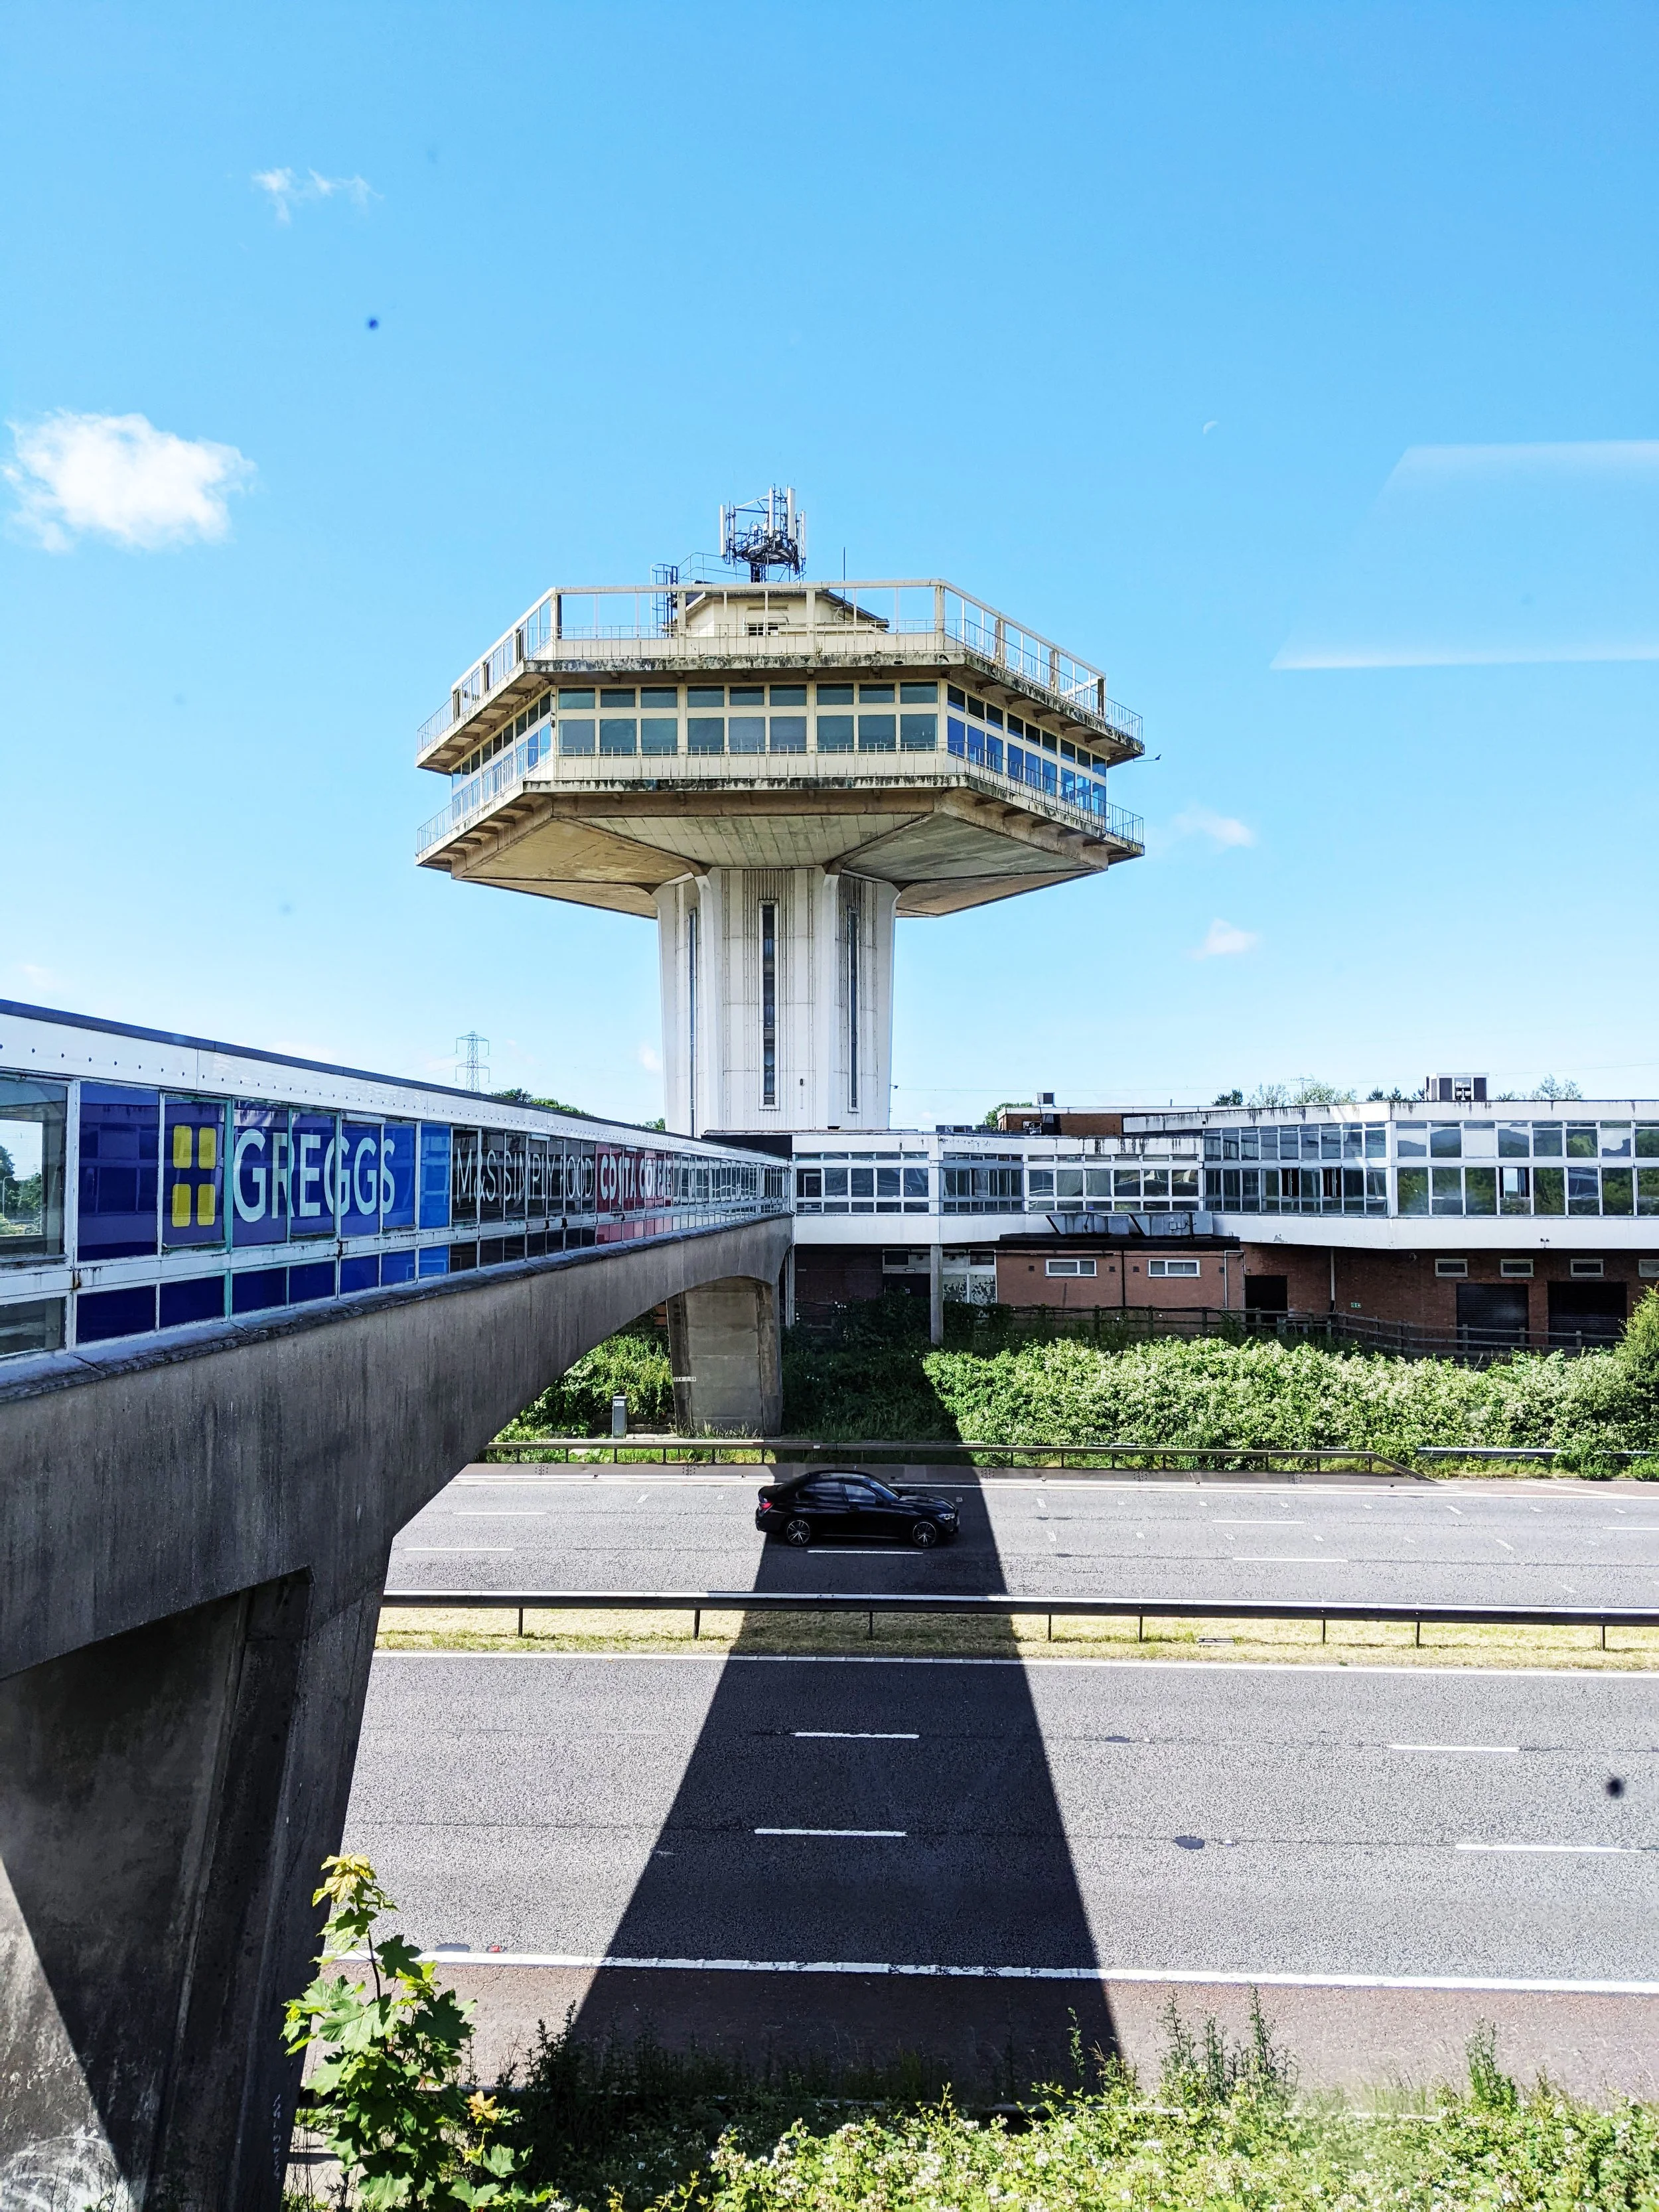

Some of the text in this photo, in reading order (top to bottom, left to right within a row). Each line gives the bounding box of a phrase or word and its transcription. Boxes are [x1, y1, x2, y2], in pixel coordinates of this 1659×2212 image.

[233, 1129, 396, 1222] GREGGS
[457, 1147, 593, 1203] M&S SIMPLY FOOD
[601, 1154, 636, 1207] COSTA
